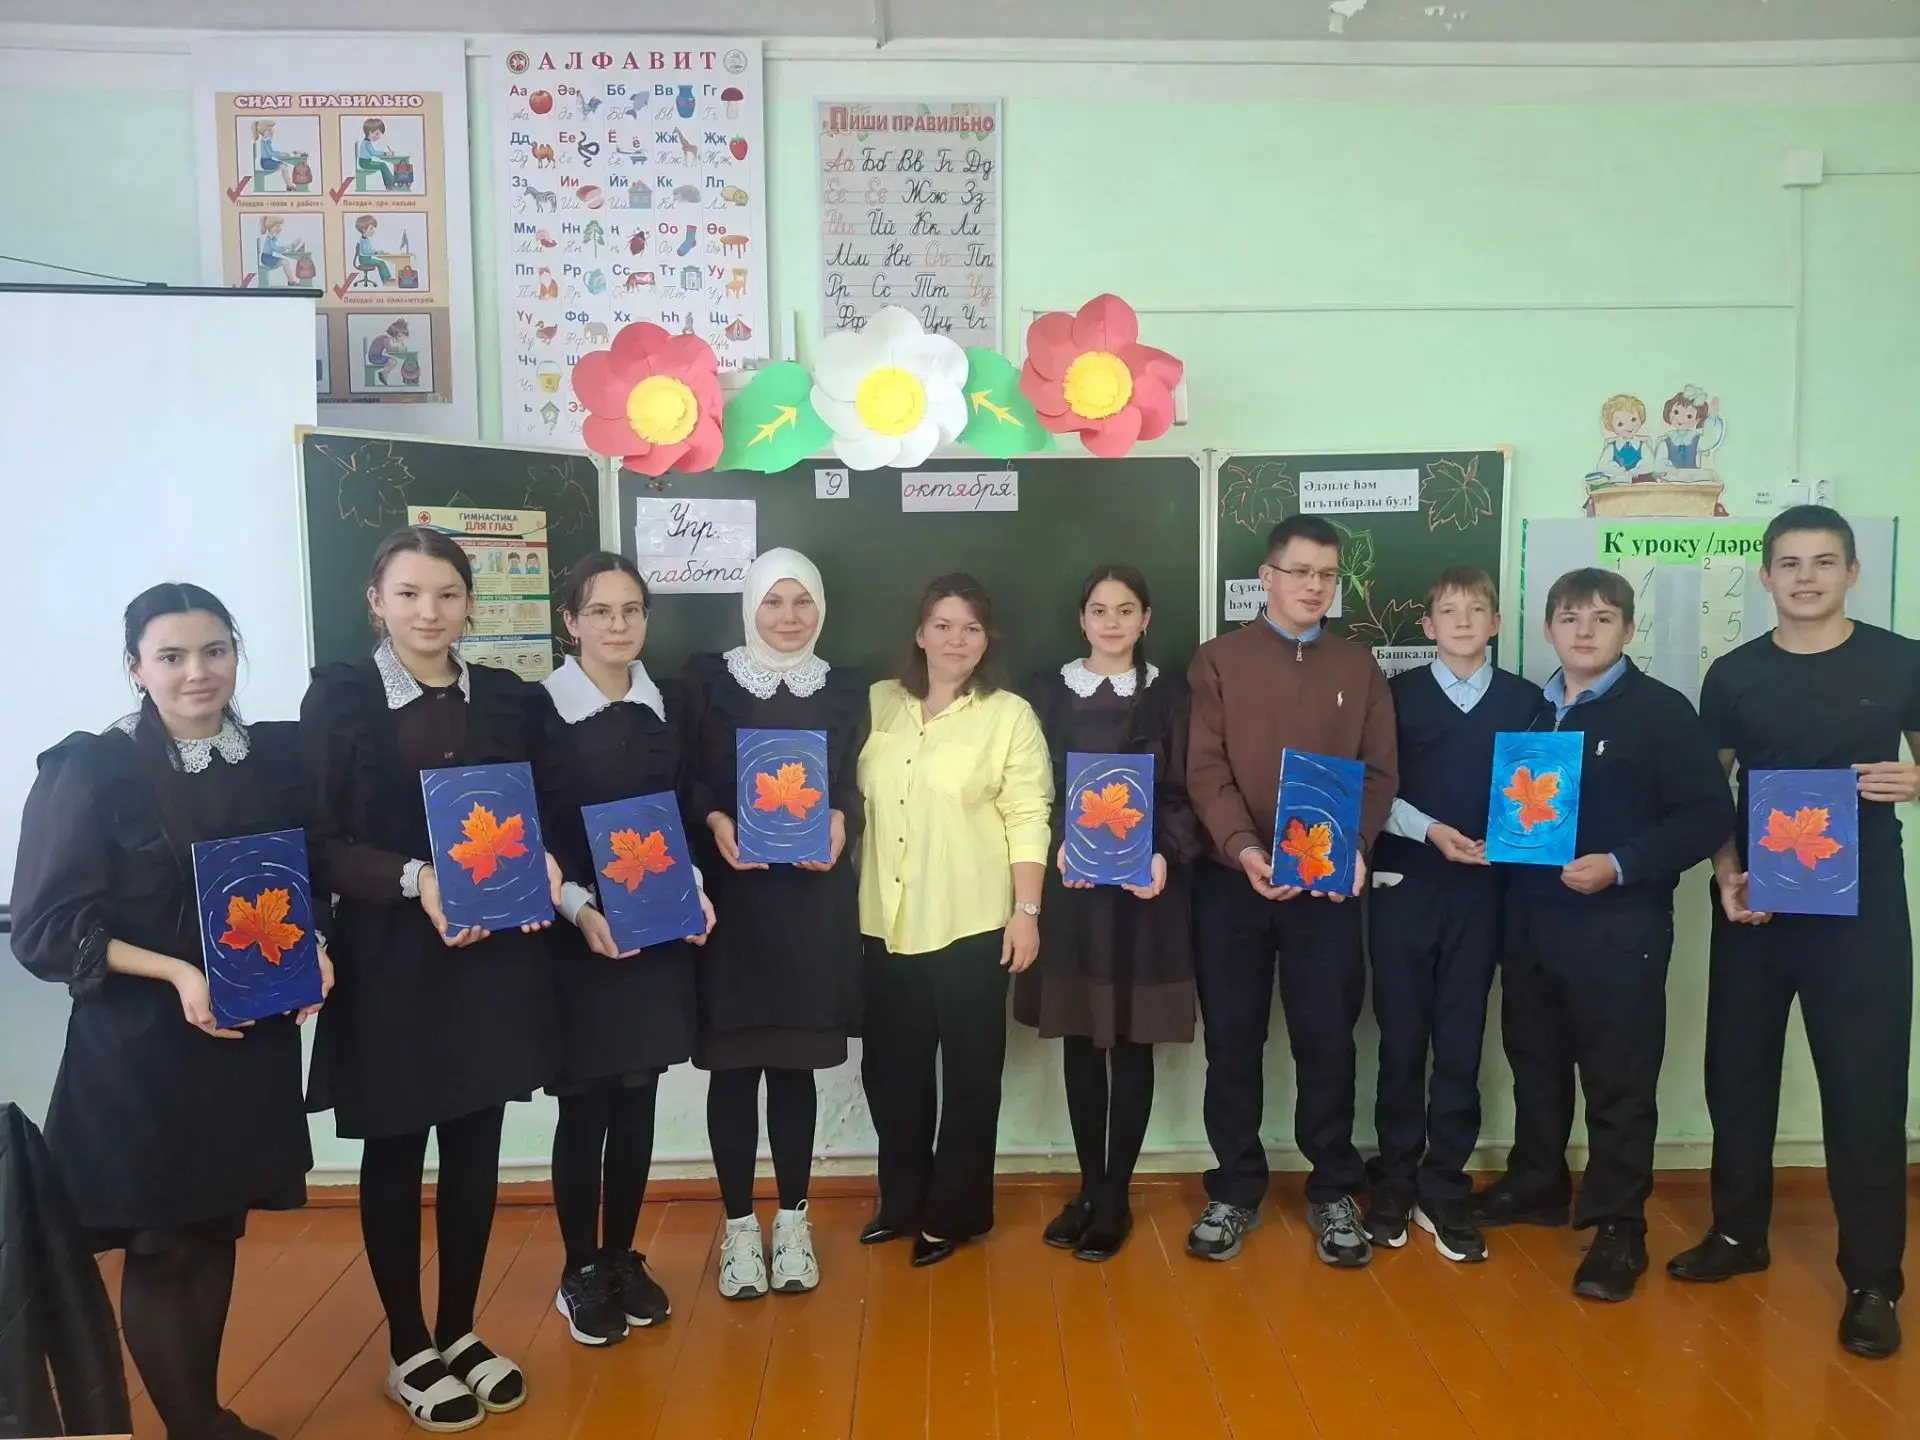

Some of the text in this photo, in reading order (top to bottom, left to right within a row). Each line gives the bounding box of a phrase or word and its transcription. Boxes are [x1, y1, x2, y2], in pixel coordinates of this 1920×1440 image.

[510, 84, 717, 96] Аа Әә Бб Вв Гг
[234, 95, 424, 109] СИДИ ПРАВИЛЬНО
[510, 132, 530, 146] Дд
[559, 132, 576, 143] Ее
[655, 132, 678, 144] Жж
[862, 147, 893, 172] Бб
[897, 148, 925, 172] Вв
[963, 149, 995, 181] Дд
[512, 174, 725, 188] Зз Ии Йй Кк Лл
[960, 180, 987, 214] Зз
[514, 222, 536, 234] Мм
[562, 222, 580, 234] Нн
[659, 222, 678, 234] Оо
[964, 243, 993, 267] Пп
[515, 264, 725, 279] Пп Рр Сс Тт Уу
[911, 272, 949, 298] Тт
[565, 311, 589, 325] Фф
[614, 311, 631, 322] Хх
[709, 312, 728, 324] Цц
[518, 354, 536, 366] Чч
[826, 473, 843, 496] 9
[459, 512, 518, 521] ГИМНАСТИКА
[465, 521, 513, 531] ДЛЯ ГЛАЗ
[1604, 532, 1624, 553] К
[1632, 538, 1701, 558] уроку
[1703, 557, 1711, 570] 2
[1640, 566, 1655, 600] 1
[1724, 566, 1744, 598] 2
[1702, 601, 1709, 614] 5
[1637, 612, 1653, 643] 4
[1723, 611, 1742, 642] 5
[1700, 646, 1708, 659] 8
